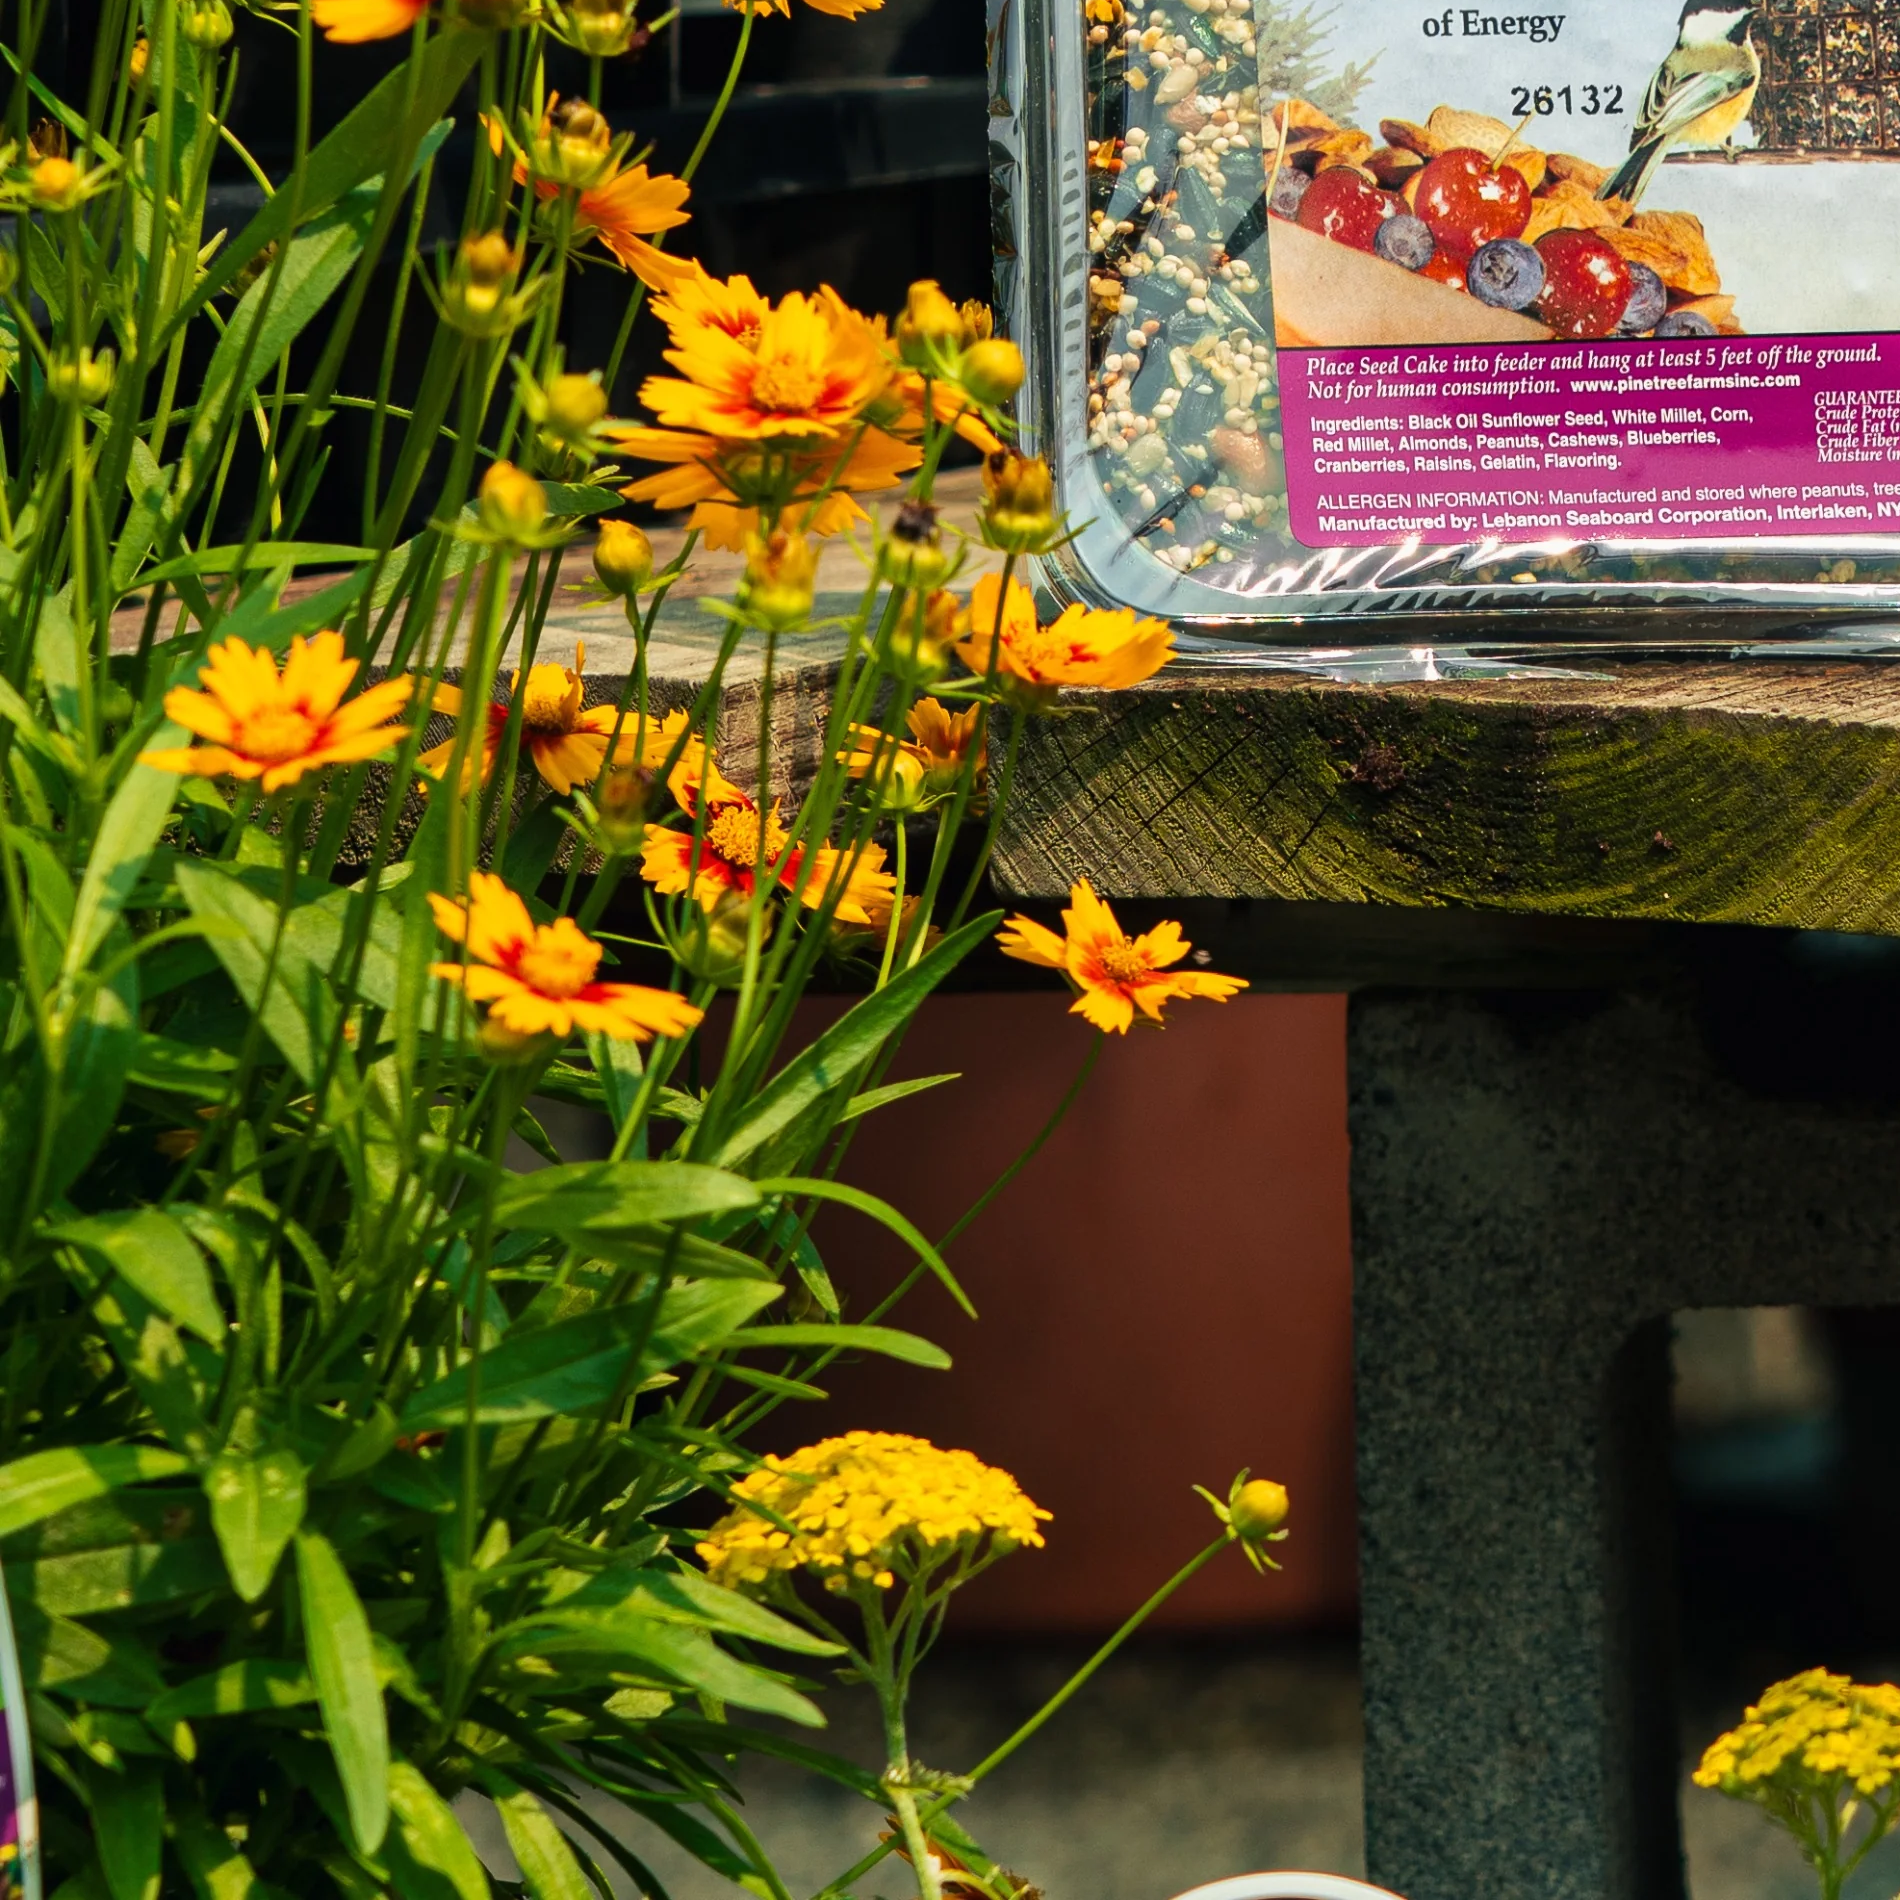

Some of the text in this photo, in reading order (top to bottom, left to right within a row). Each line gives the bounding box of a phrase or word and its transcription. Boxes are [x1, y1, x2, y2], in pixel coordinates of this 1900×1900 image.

[1422, 9, 1565, 42] of Energy
[1511, 84, 1623, 116] 26132
[1307, 343, 1882, 377] Place Seed Cake into feeder and hang at least 5 feet off the ground.
[1308, 373, 1801, 403] Not for human consumption. www.pinetreefarmsinc.com
[1311, 406, 1753, 435] Ingredients: Black Oil Sunflower Seed, White Millet, Corn,
[1815, 405, 1857, 420] Crude
[1816, 419, 1857, 434] Crude
[1862, 419, 1886, 433] Fat
[1312, 429, 1721, 453] Red Millet, Almonds, Peanuts, Cashews, Blueberries,
[1817, 433, 1858, 449] Crude
[1863, 432, 1899, 447] Fiber
[1314, 452, 1622, 475] Cranberries, Raisins, Gelatin, Flavoring.
[1817, 448, 1882, 462] Moisture
[1317, 494, 1411, 510] ALLERGEN
[1416, 491, 1545, 508] INFORMATION:
[1549, 487, 1656, 505] Manufactured
[1661, 487, 1691, 501] and
[1696, 485, 1744, 501] stored
[1749, 484, 1797, 498] where
[1802, 483, 1869, 500] peanuts,
[1319, 513, 1446, 531] Manufactured
[1450, 512, 1478, 529] by:
[1482, 511, 1561, 528] Lebanon
[1566, 509, 1653, 526] Seaboard
[1658, 505, 1773, 524] Corporation,
[1777, 503, 1872, 520] Interlaken,
